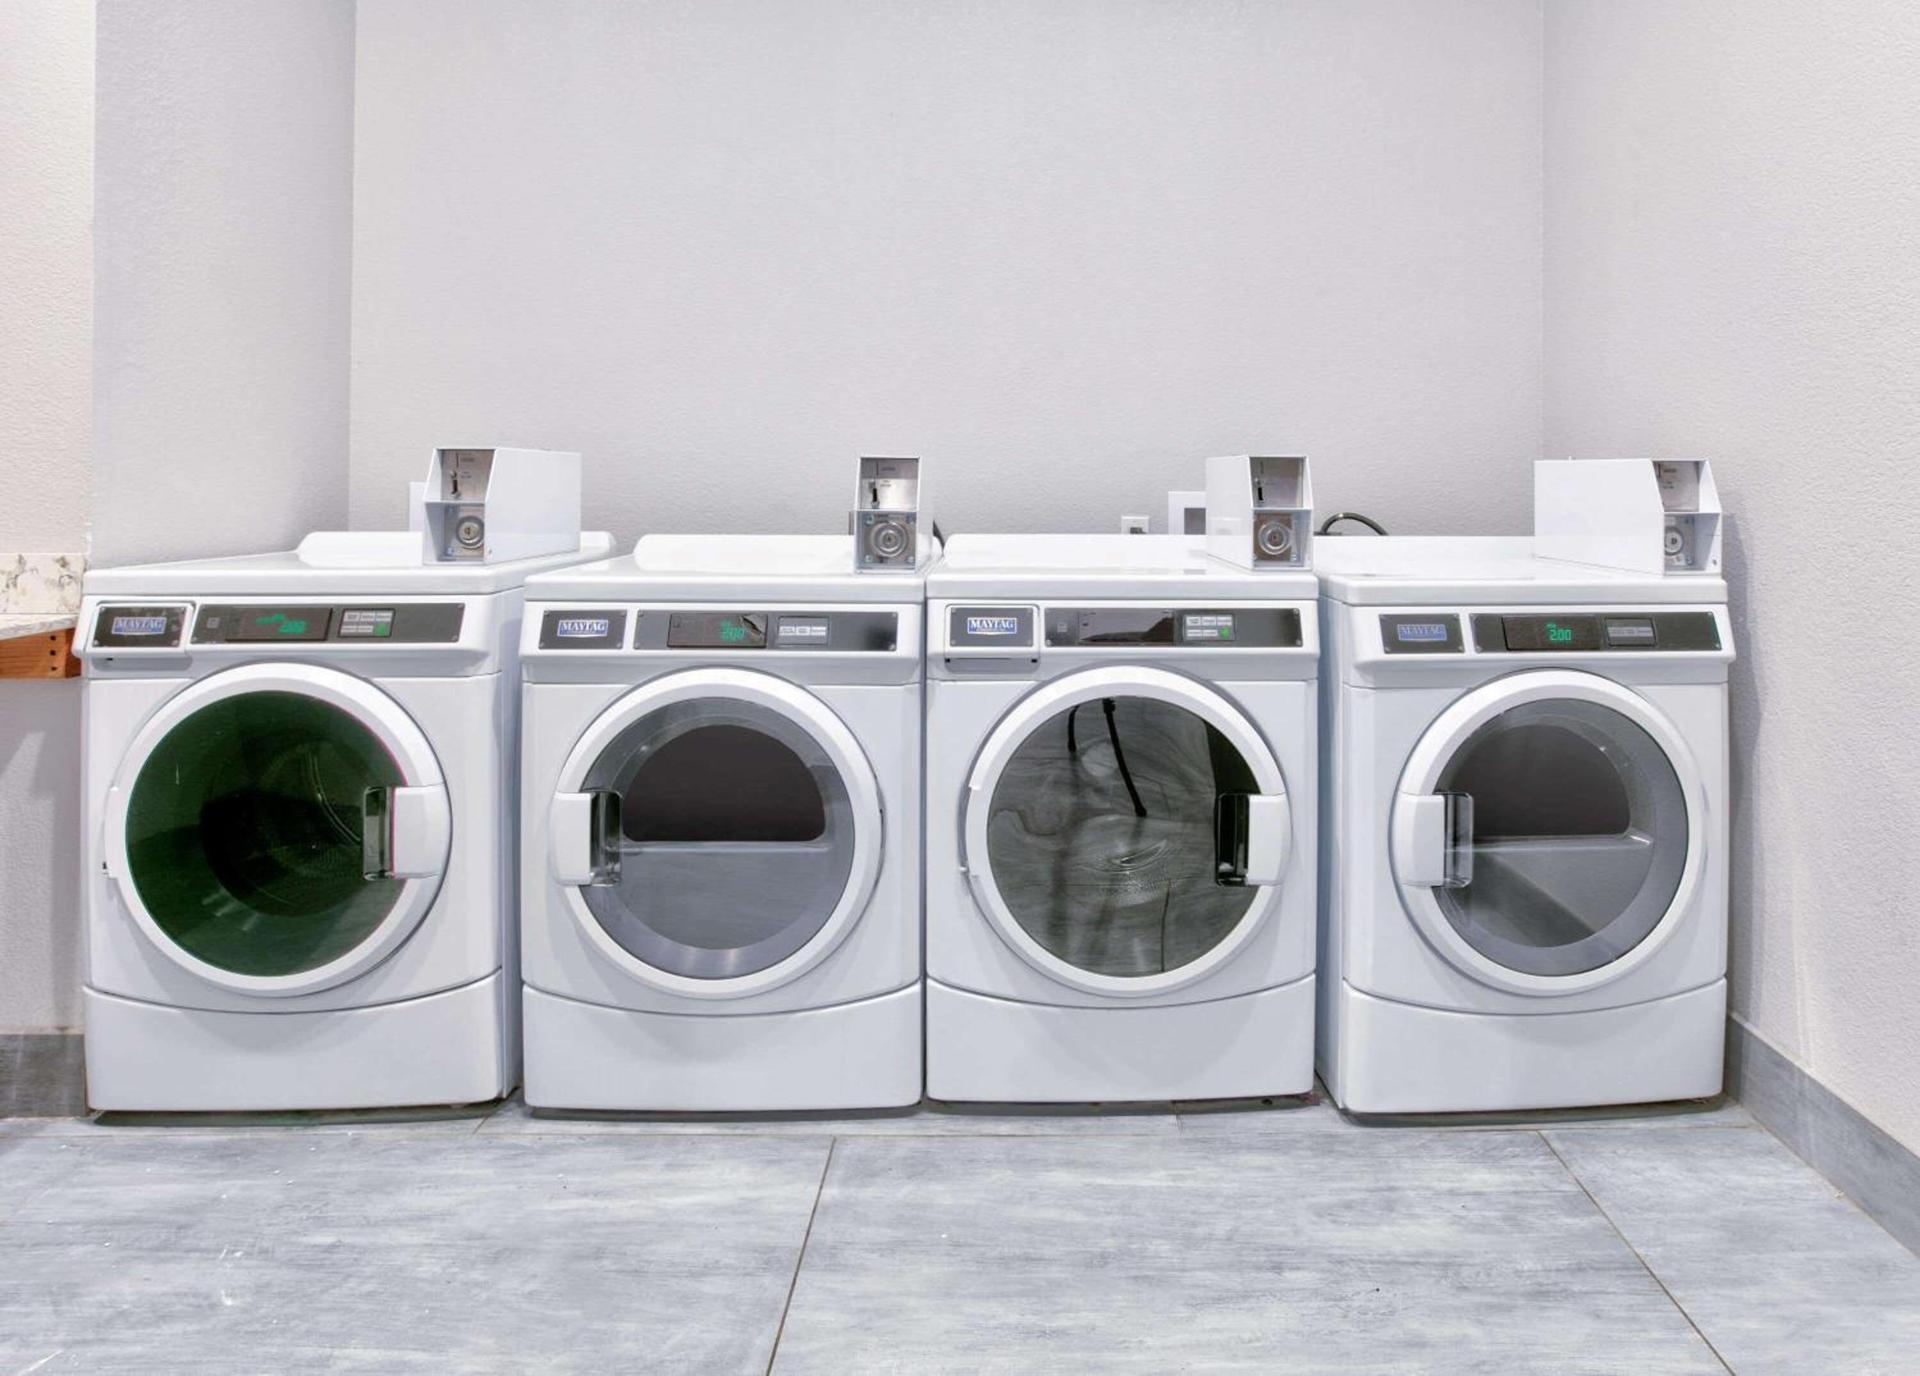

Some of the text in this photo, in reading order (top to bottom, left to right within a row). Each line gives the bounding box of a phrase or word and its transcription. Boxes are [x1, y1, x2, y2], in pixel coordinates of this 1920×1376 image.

[116, 619, 163, 629] MAYTAG
[560, 621, 605, 631] MAYTAG
[970, 619, 1014, 628] MAYTAG
[1400, 625, 1444, 634] MAYTAG
